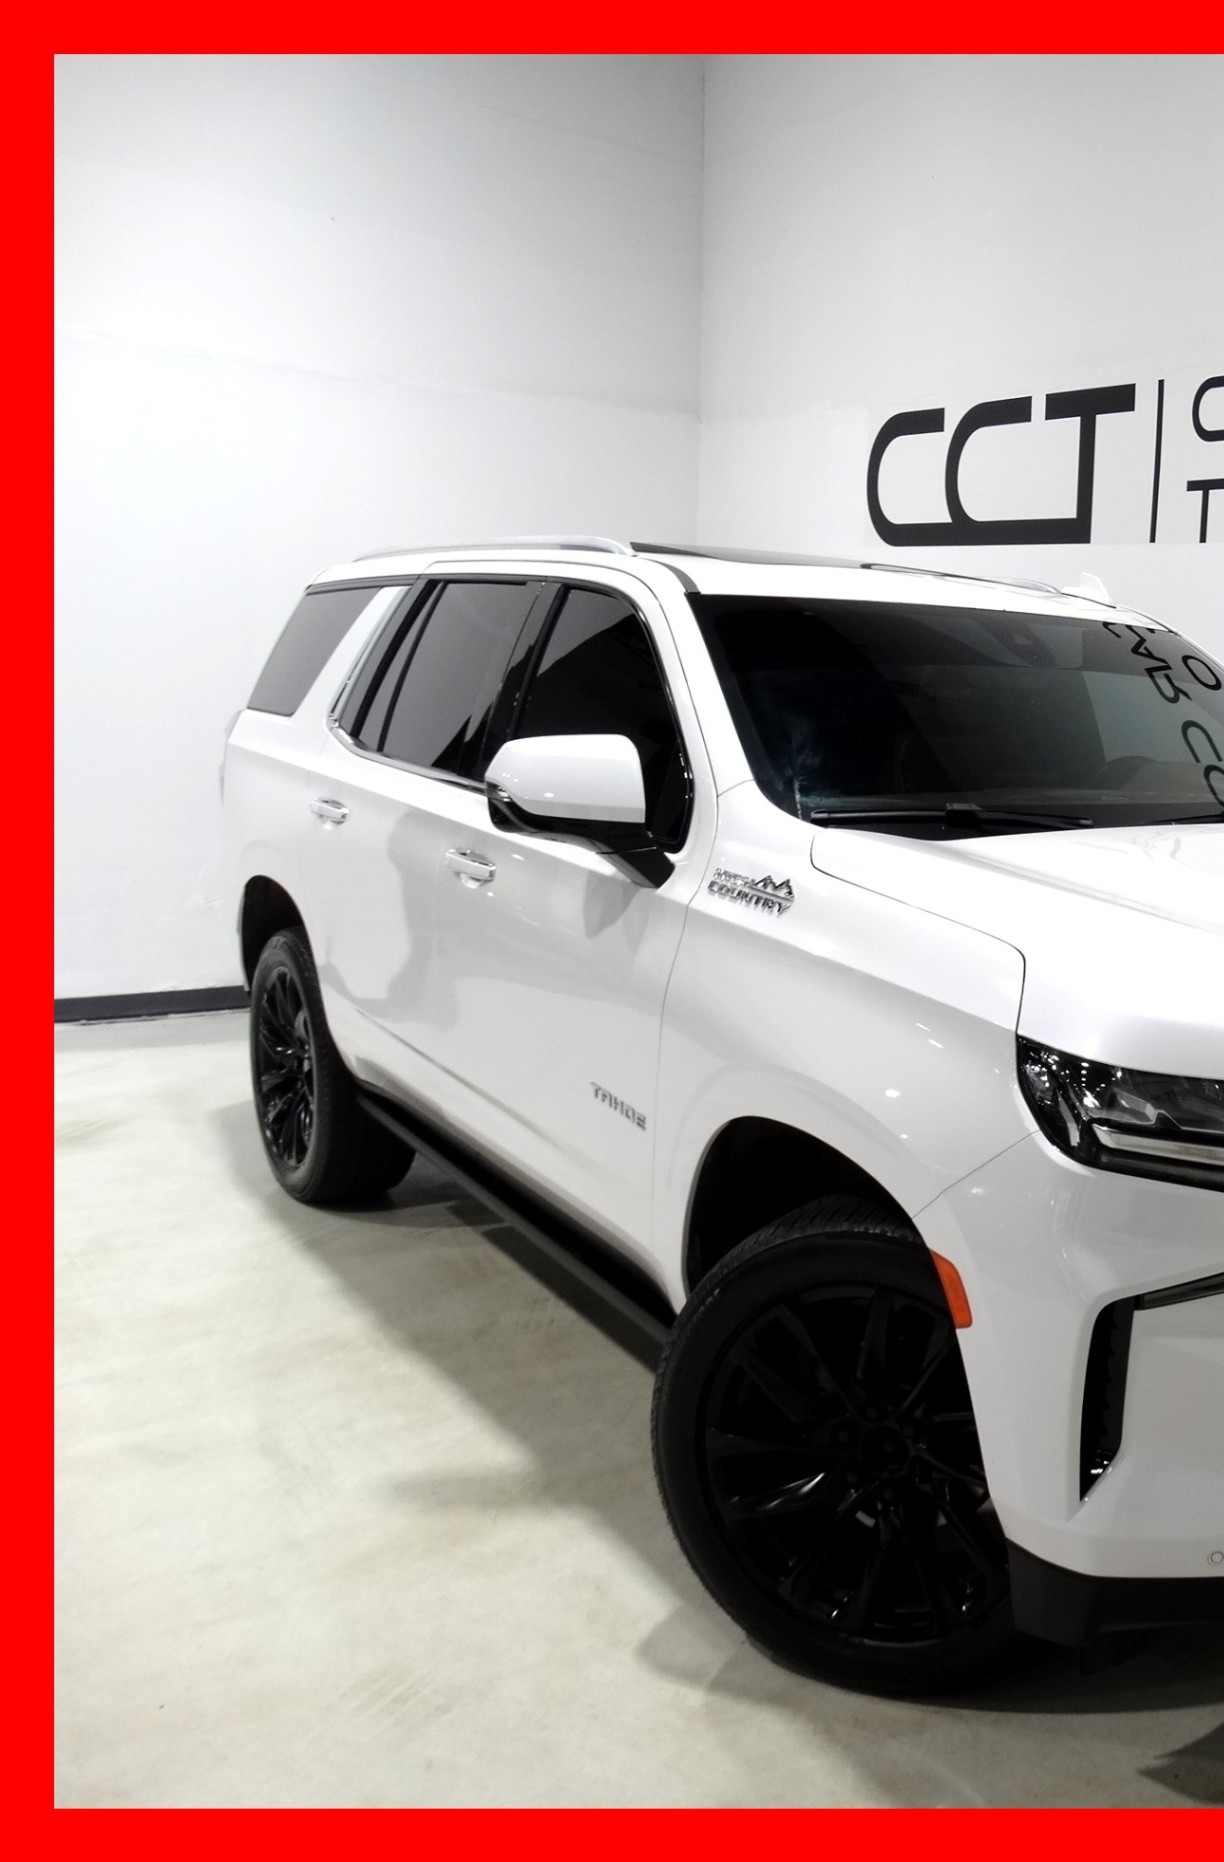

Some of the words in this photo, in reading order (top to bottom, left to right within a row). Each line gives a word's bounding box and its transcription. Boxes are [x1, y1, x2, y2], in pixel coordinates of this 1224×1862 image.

[867, 383, 1136, 547] CCT
[707, 880, 793, 915] COUNTRY
[590, 1081, 647, 1132] TAHOE
